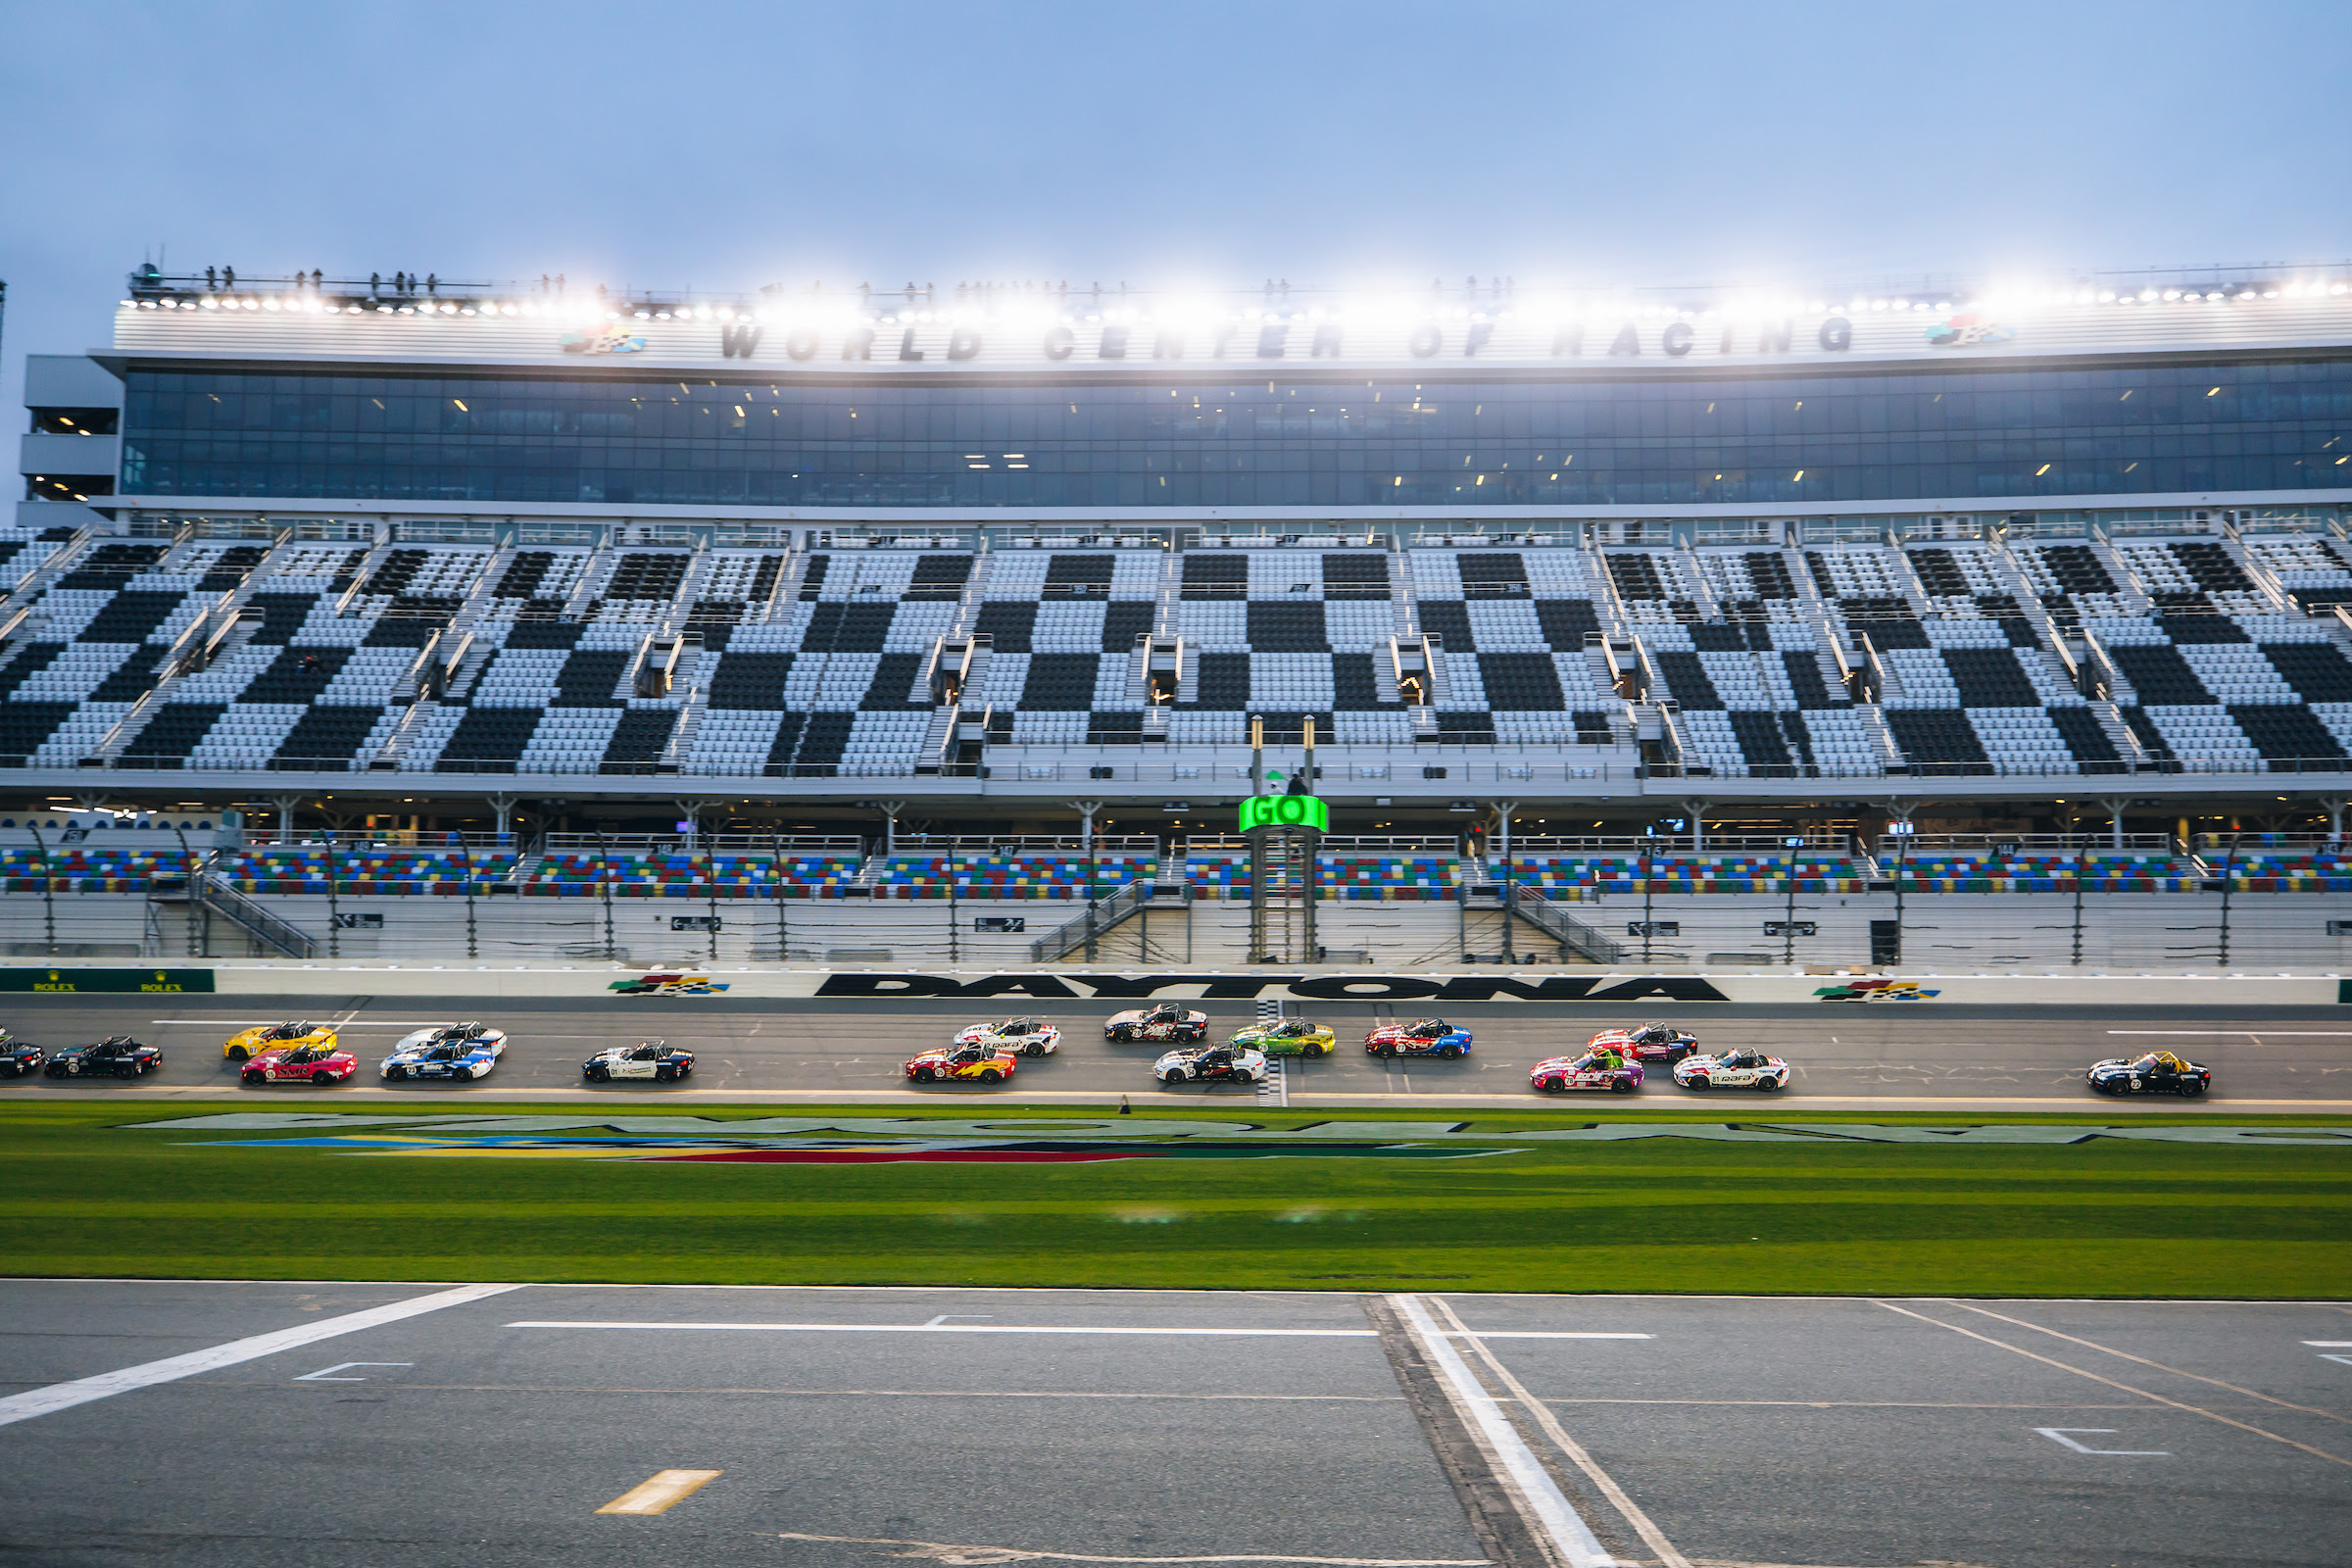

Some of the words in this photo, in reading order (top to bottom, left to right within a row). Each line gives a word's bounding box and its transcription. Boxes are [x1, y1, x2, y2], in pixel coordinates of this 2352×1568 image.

[721, 324, 981, 361] WORLD
[1044, 324, 1344, 360] CENTER
[1409, 323, 1497, 358] OF
[1551, 317, 1852, 357] RACING
[1254, 796, 1305, 825] GO
[1645, 846, 1662, 858] 15
[34, 983, 75, 992] ROLEX
[141, 983, 182, 992] ROLEX
[814, 973, 1731, 1001] DAYTONA
